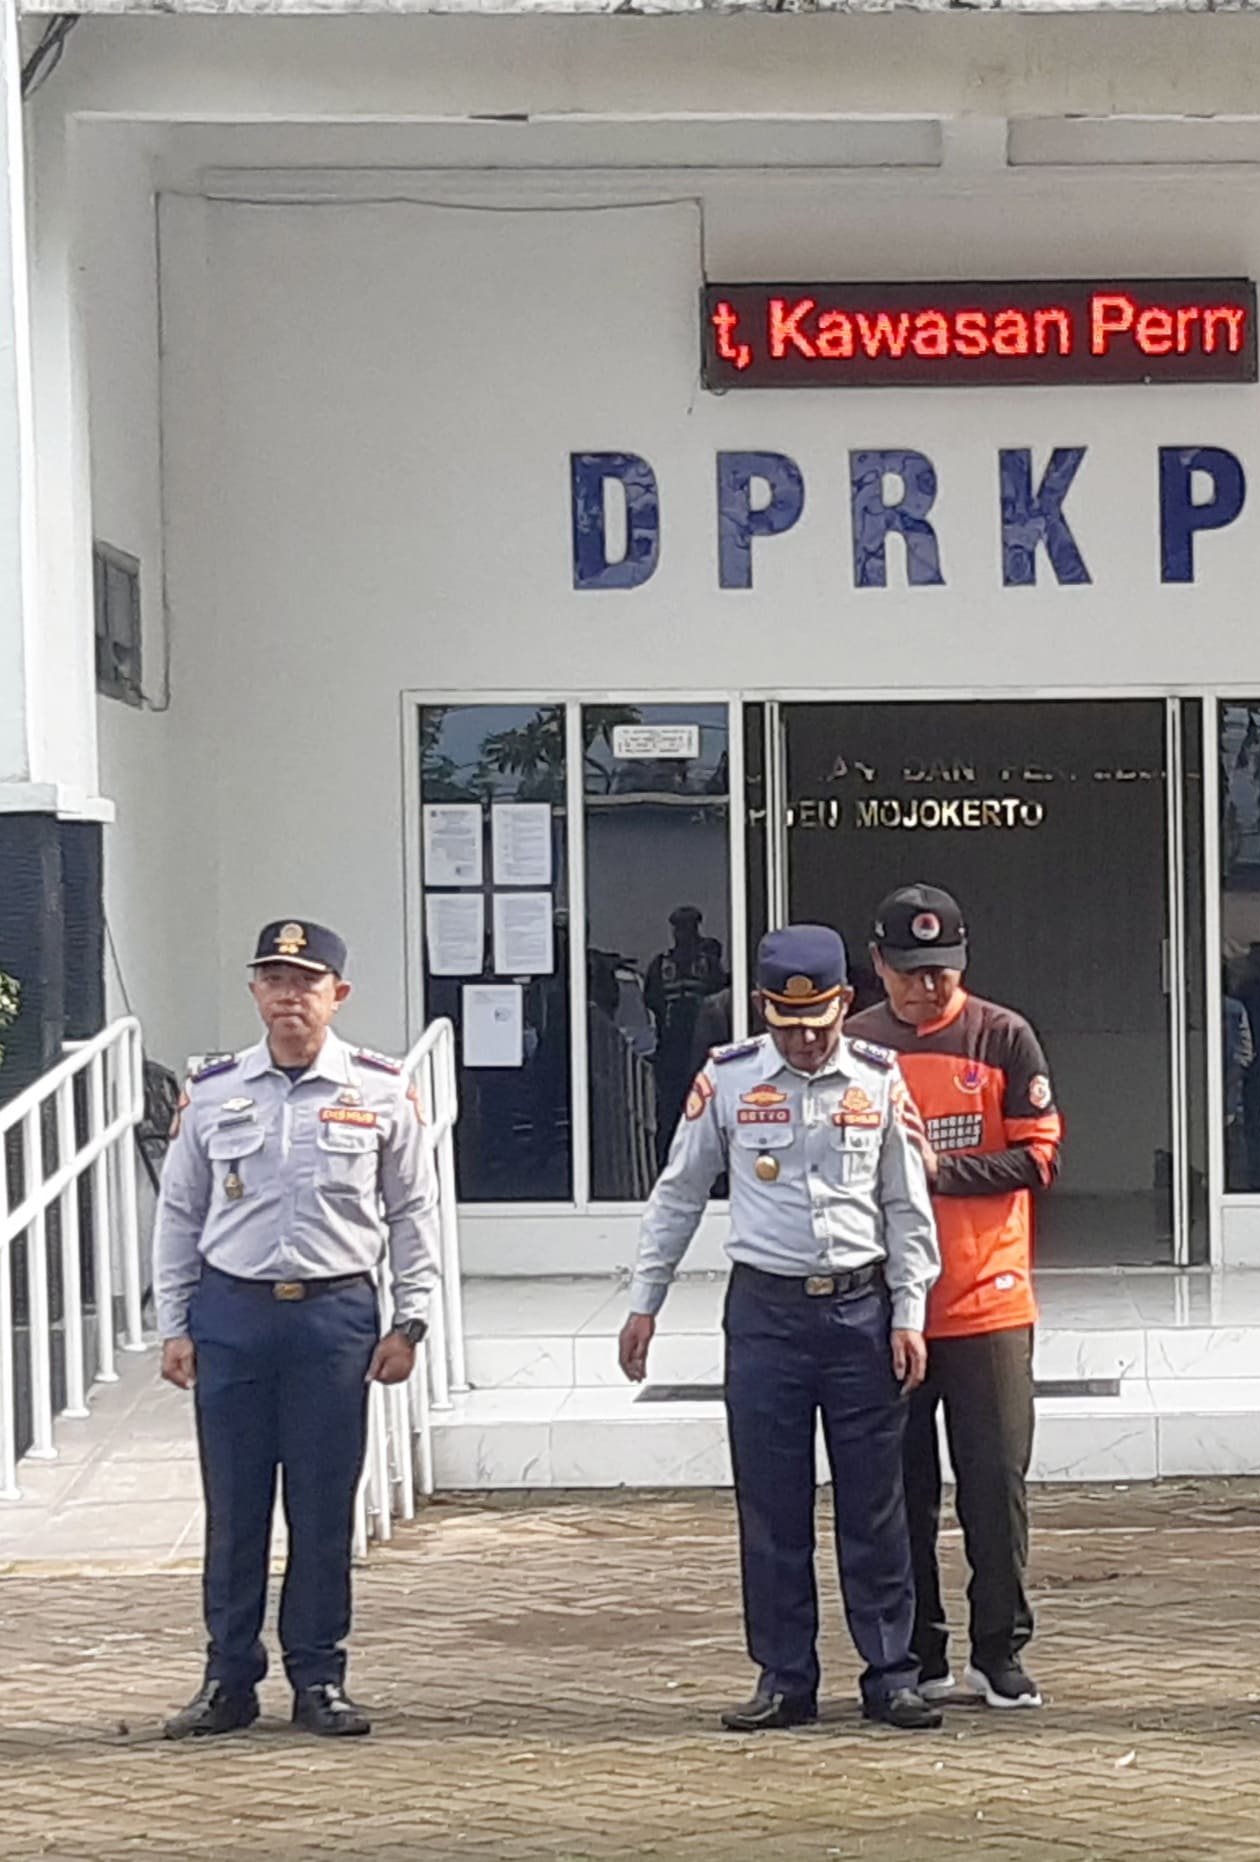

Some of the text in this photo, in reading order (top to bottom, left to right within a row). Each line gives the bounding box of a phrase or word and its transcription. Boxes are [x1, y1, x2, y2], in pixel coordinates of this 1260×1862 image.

[712, 302, 751, 369] t,
[769, 299, 1071, 358] Kawasan
[856, 798, 1044, 829] MOJOKERTO
